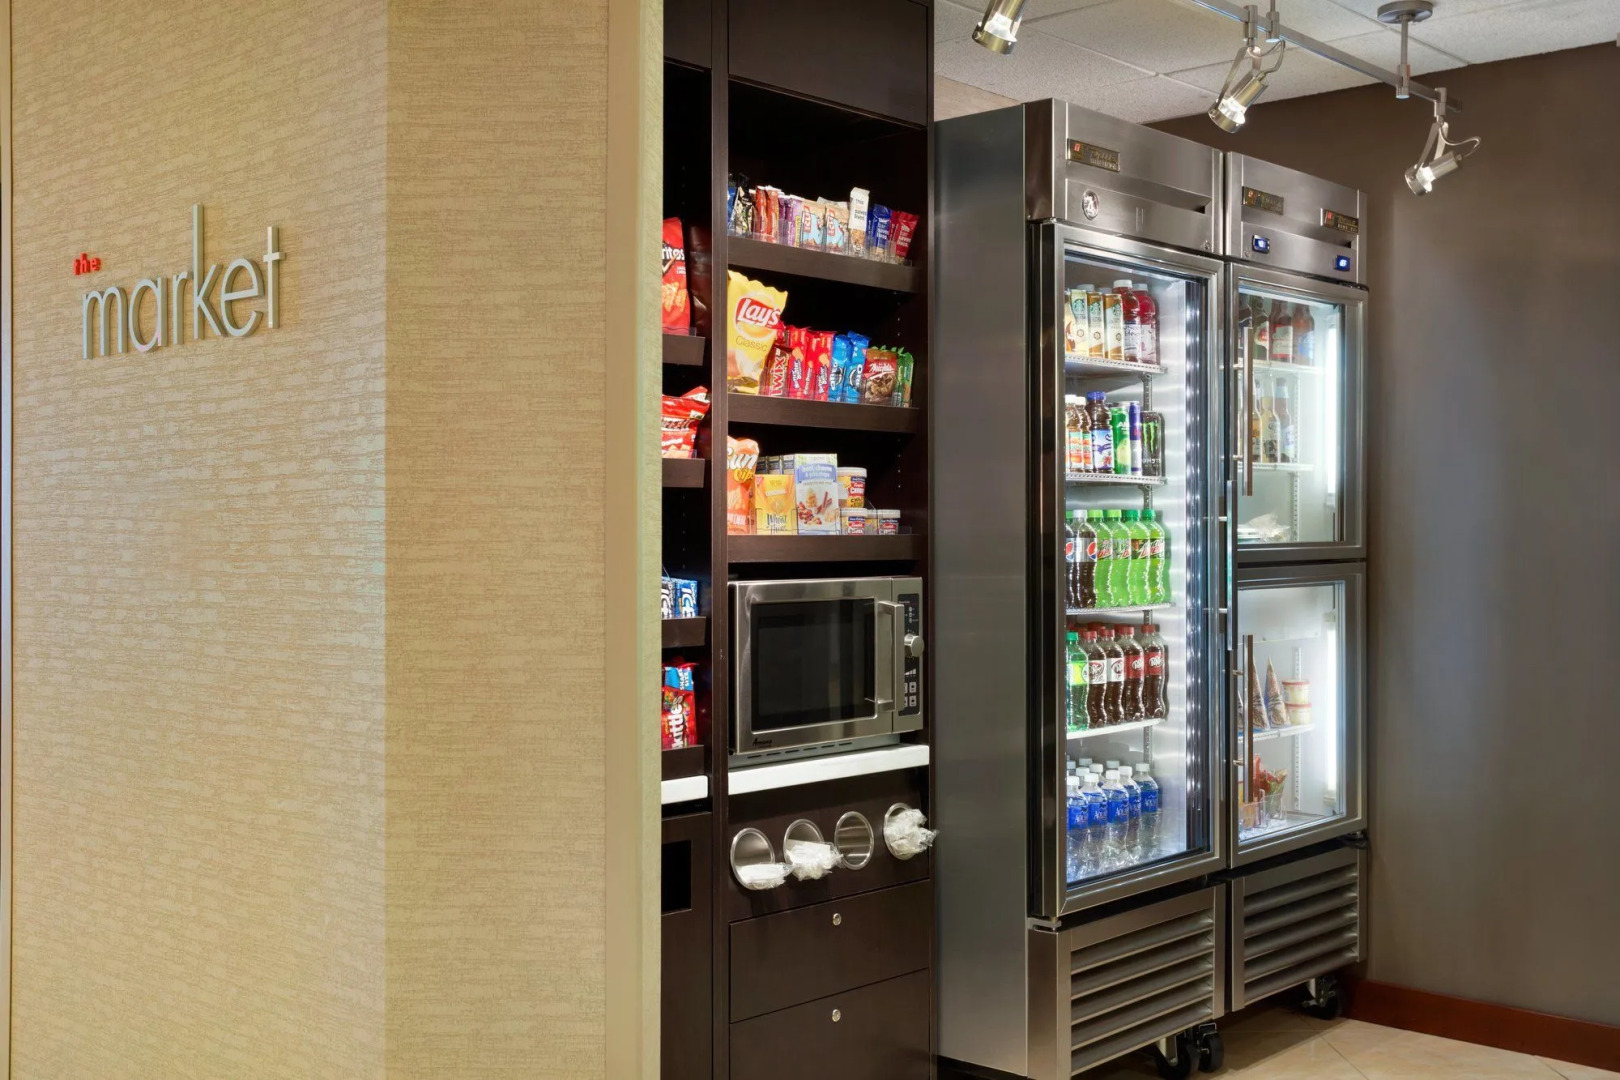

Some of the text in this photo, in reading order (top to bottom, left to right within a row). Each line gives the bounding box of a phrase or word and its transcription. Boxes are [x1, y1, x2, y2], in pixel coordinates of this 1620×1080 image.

[73, 252, 101, 275] the
[82, 204, 287, 360] market
[735, 335, 768, 352] Classic
[672, 695, 684, 749] kittles
